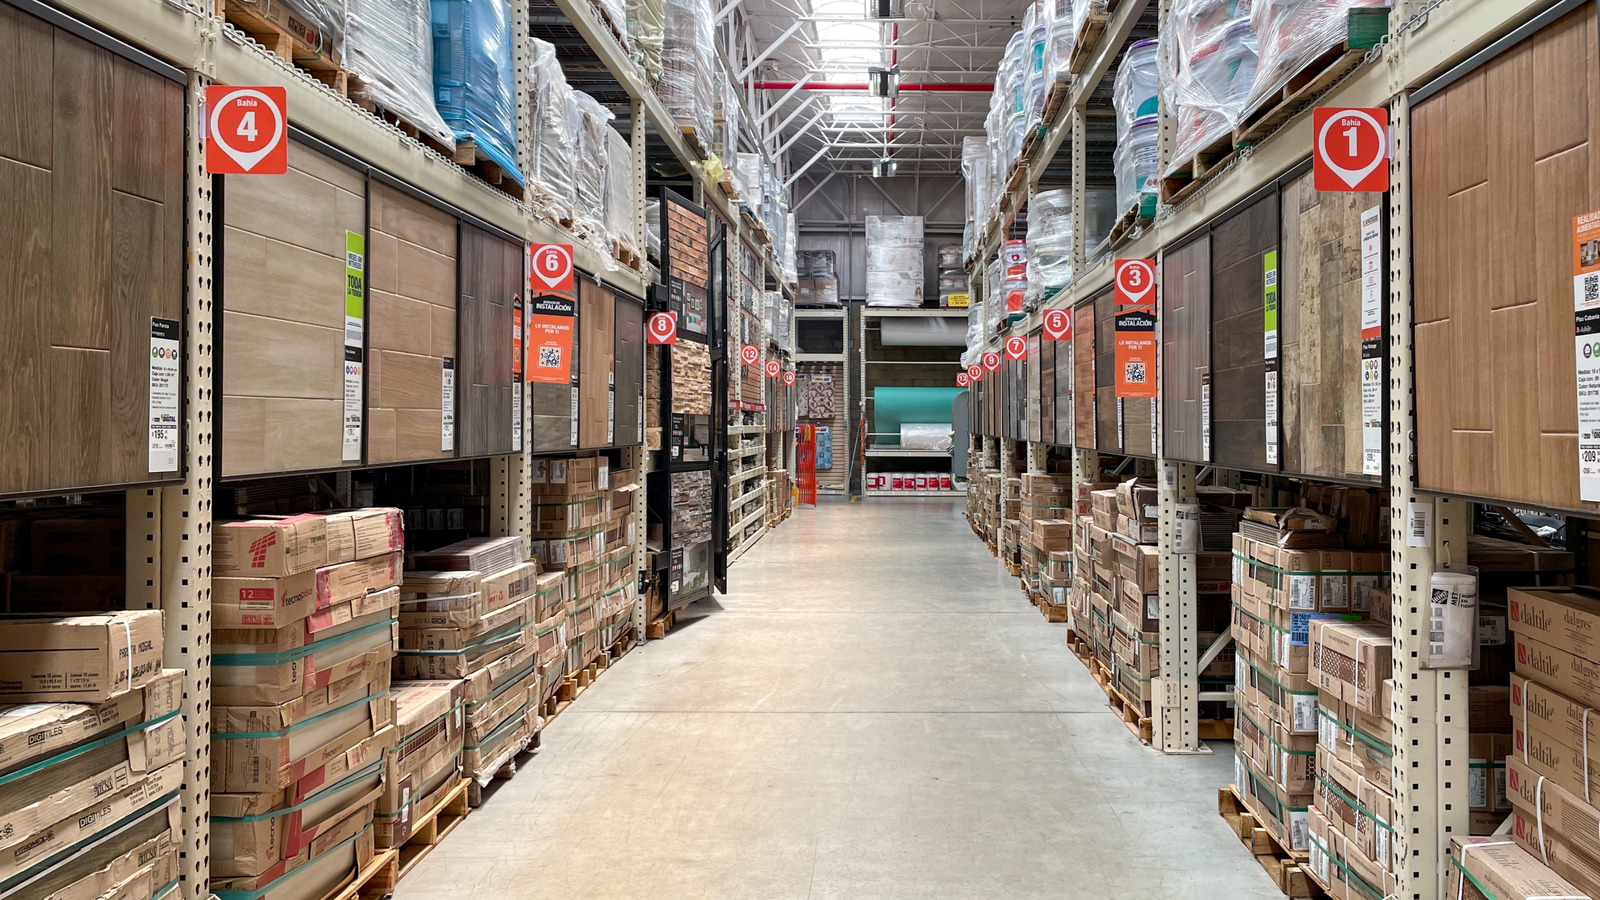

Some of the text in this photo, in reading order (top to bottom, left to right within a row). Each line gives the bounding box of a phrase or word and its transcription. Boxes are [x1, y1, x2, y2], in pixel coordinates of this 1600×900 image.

[237, 99, 257, 107] Bahía
[237, 112, 258, 142] 4
[1343, 127, 1358, 157] 1
[1577, 221, 1600, 234] AUMENTAD
[546, 254, 558, 271] 6
[347, 274, 362, 290] TODA
[1129, 269, 1141, 286] 3
[536, 302, 571, 312] INSTALACIÓN
[658, 319, 667, 331] 8
[1053, 316, 1061, 328] 5
[1013, 342, 1020, 351] 7
[241, 590, 254, 599] 12
[285, 588, 312, 606] tecnopiso
[1520, 603, 1551, 632] daltile
[1564, 609, 1592, 631] dalgres
[119, 645, 136, 659] PARTA
[1527, 647, 1559, 678] daltile
[1571, 657, 1600, 680] dalgres
[1526, 694, 1553, 722] altile
[28, 726, 63, 744] DIGITILES
[1520, 779, 1552, 816] dalile
[79, 805, 111, 828] DIGITILES
[1526, 826, 1557, 865] dalile
